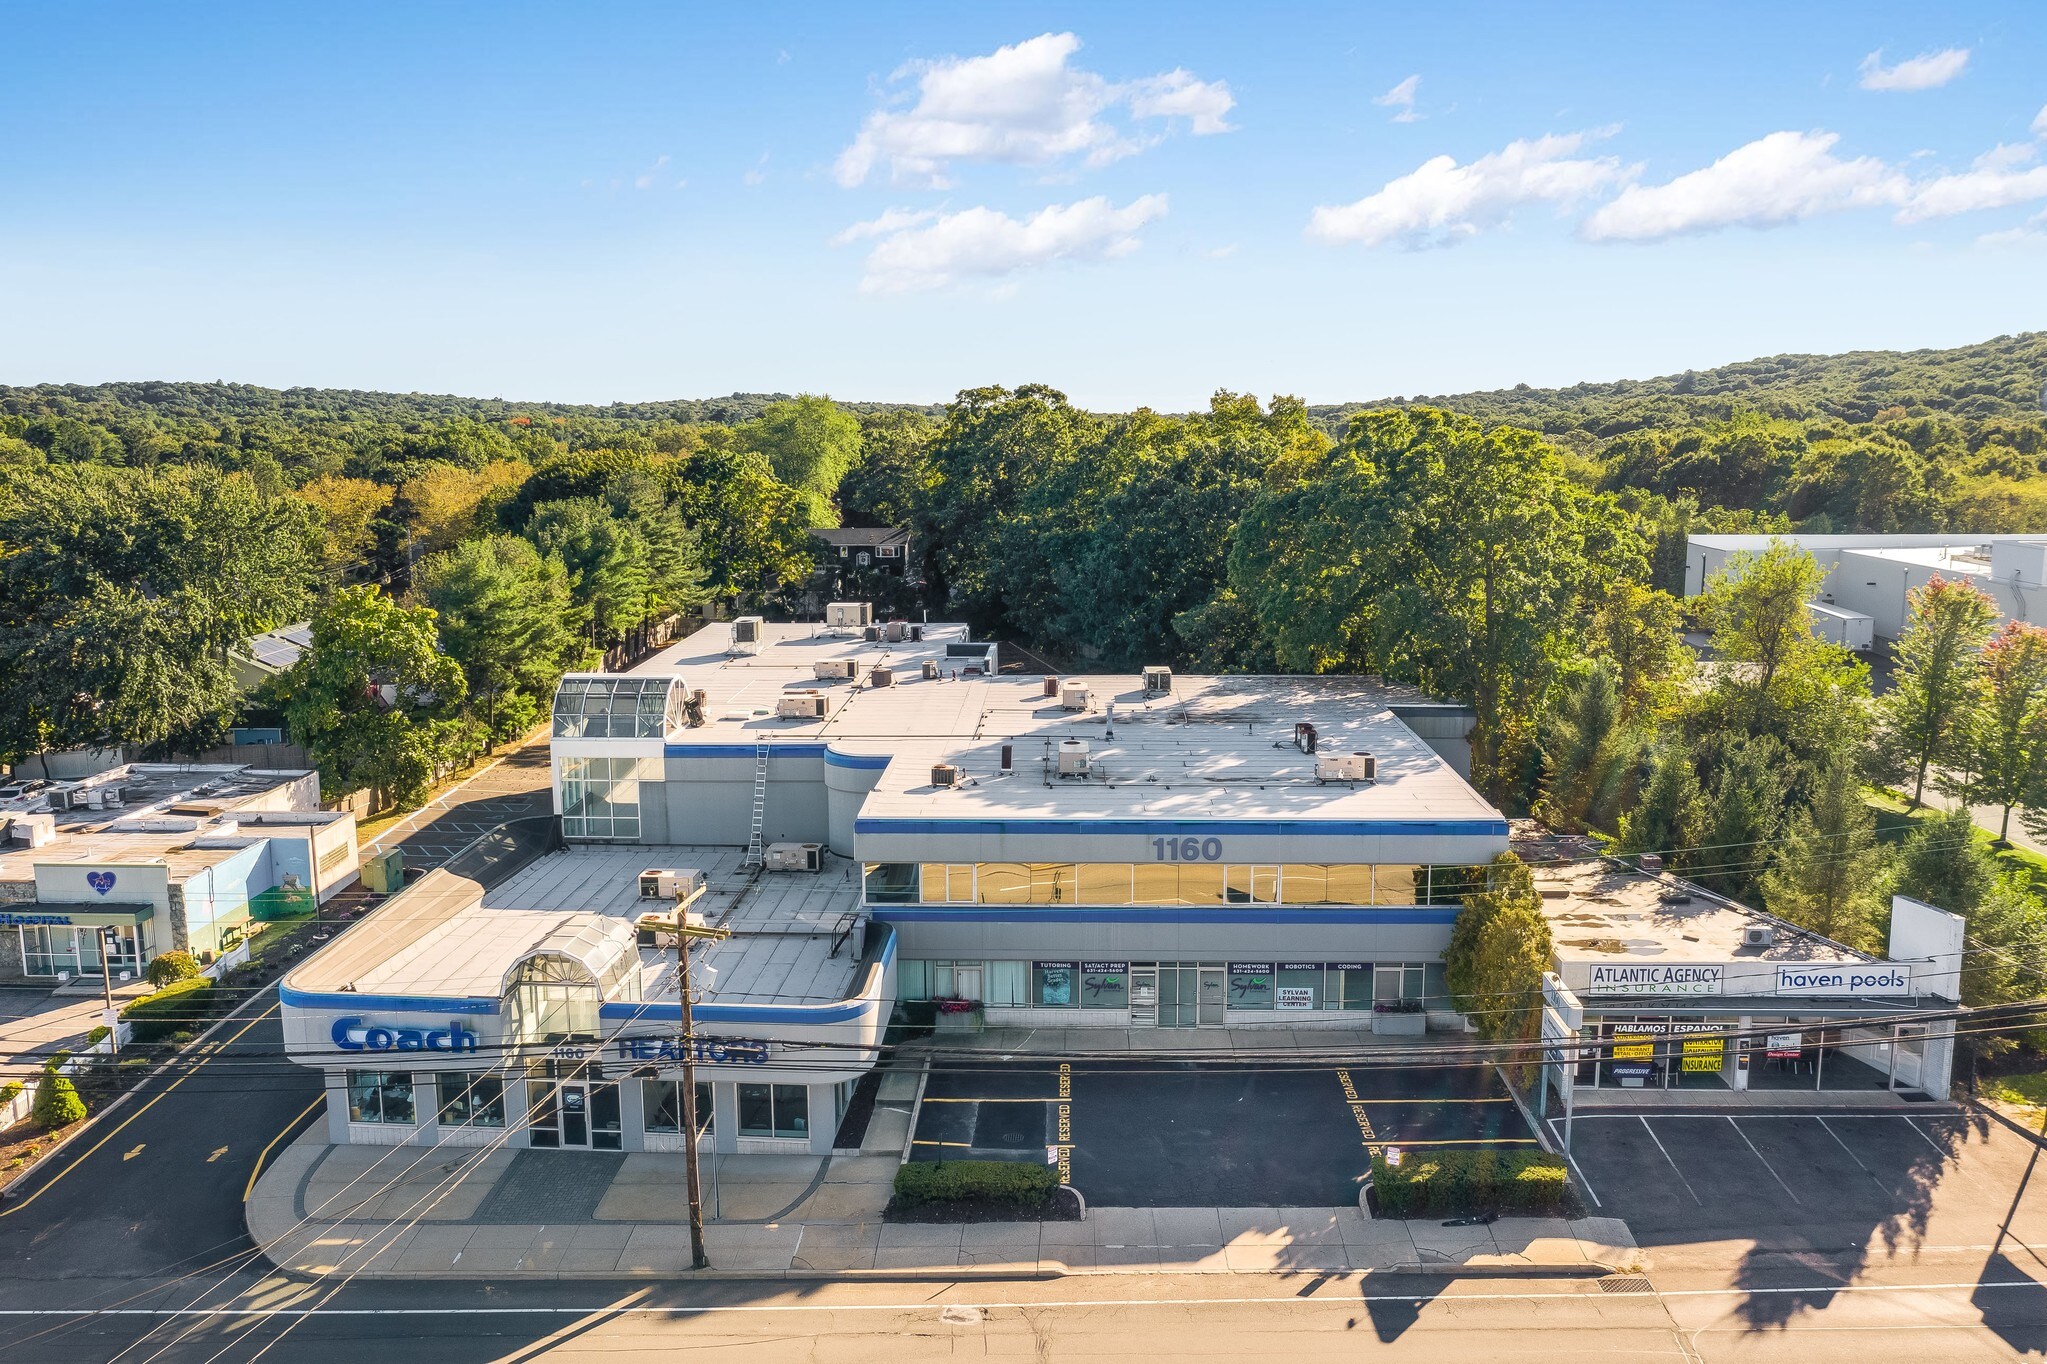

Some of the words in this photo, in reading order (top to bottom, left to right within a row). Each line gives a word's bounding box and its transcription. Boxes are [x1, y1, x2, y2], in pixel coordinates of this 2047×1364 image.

[1152, 837, 1223, 861] 1160
[1594, 967, 1659, 982] ATLANTIC
[1663, 967, 1720, 983] AGENCY
[1781, 969, 1843, 987] haven
[1850, 969, 1905, 991] pools
[1084, 977, 1125, 998] Sylvan
[1231, 977, 1271, 998] Sylvan
[331, 1018, 475, 1054] Coach
[1683, 1060, 1721, 1070] INSURANCE
[1336, 1067, 1358, 1100] ESERVED
[1059, 1104, 1070, 1141] RESERVED
[1351, 1104, 1376, 1139] RESERVED
[1058, 1147, 1070, 1184] RESERVED
